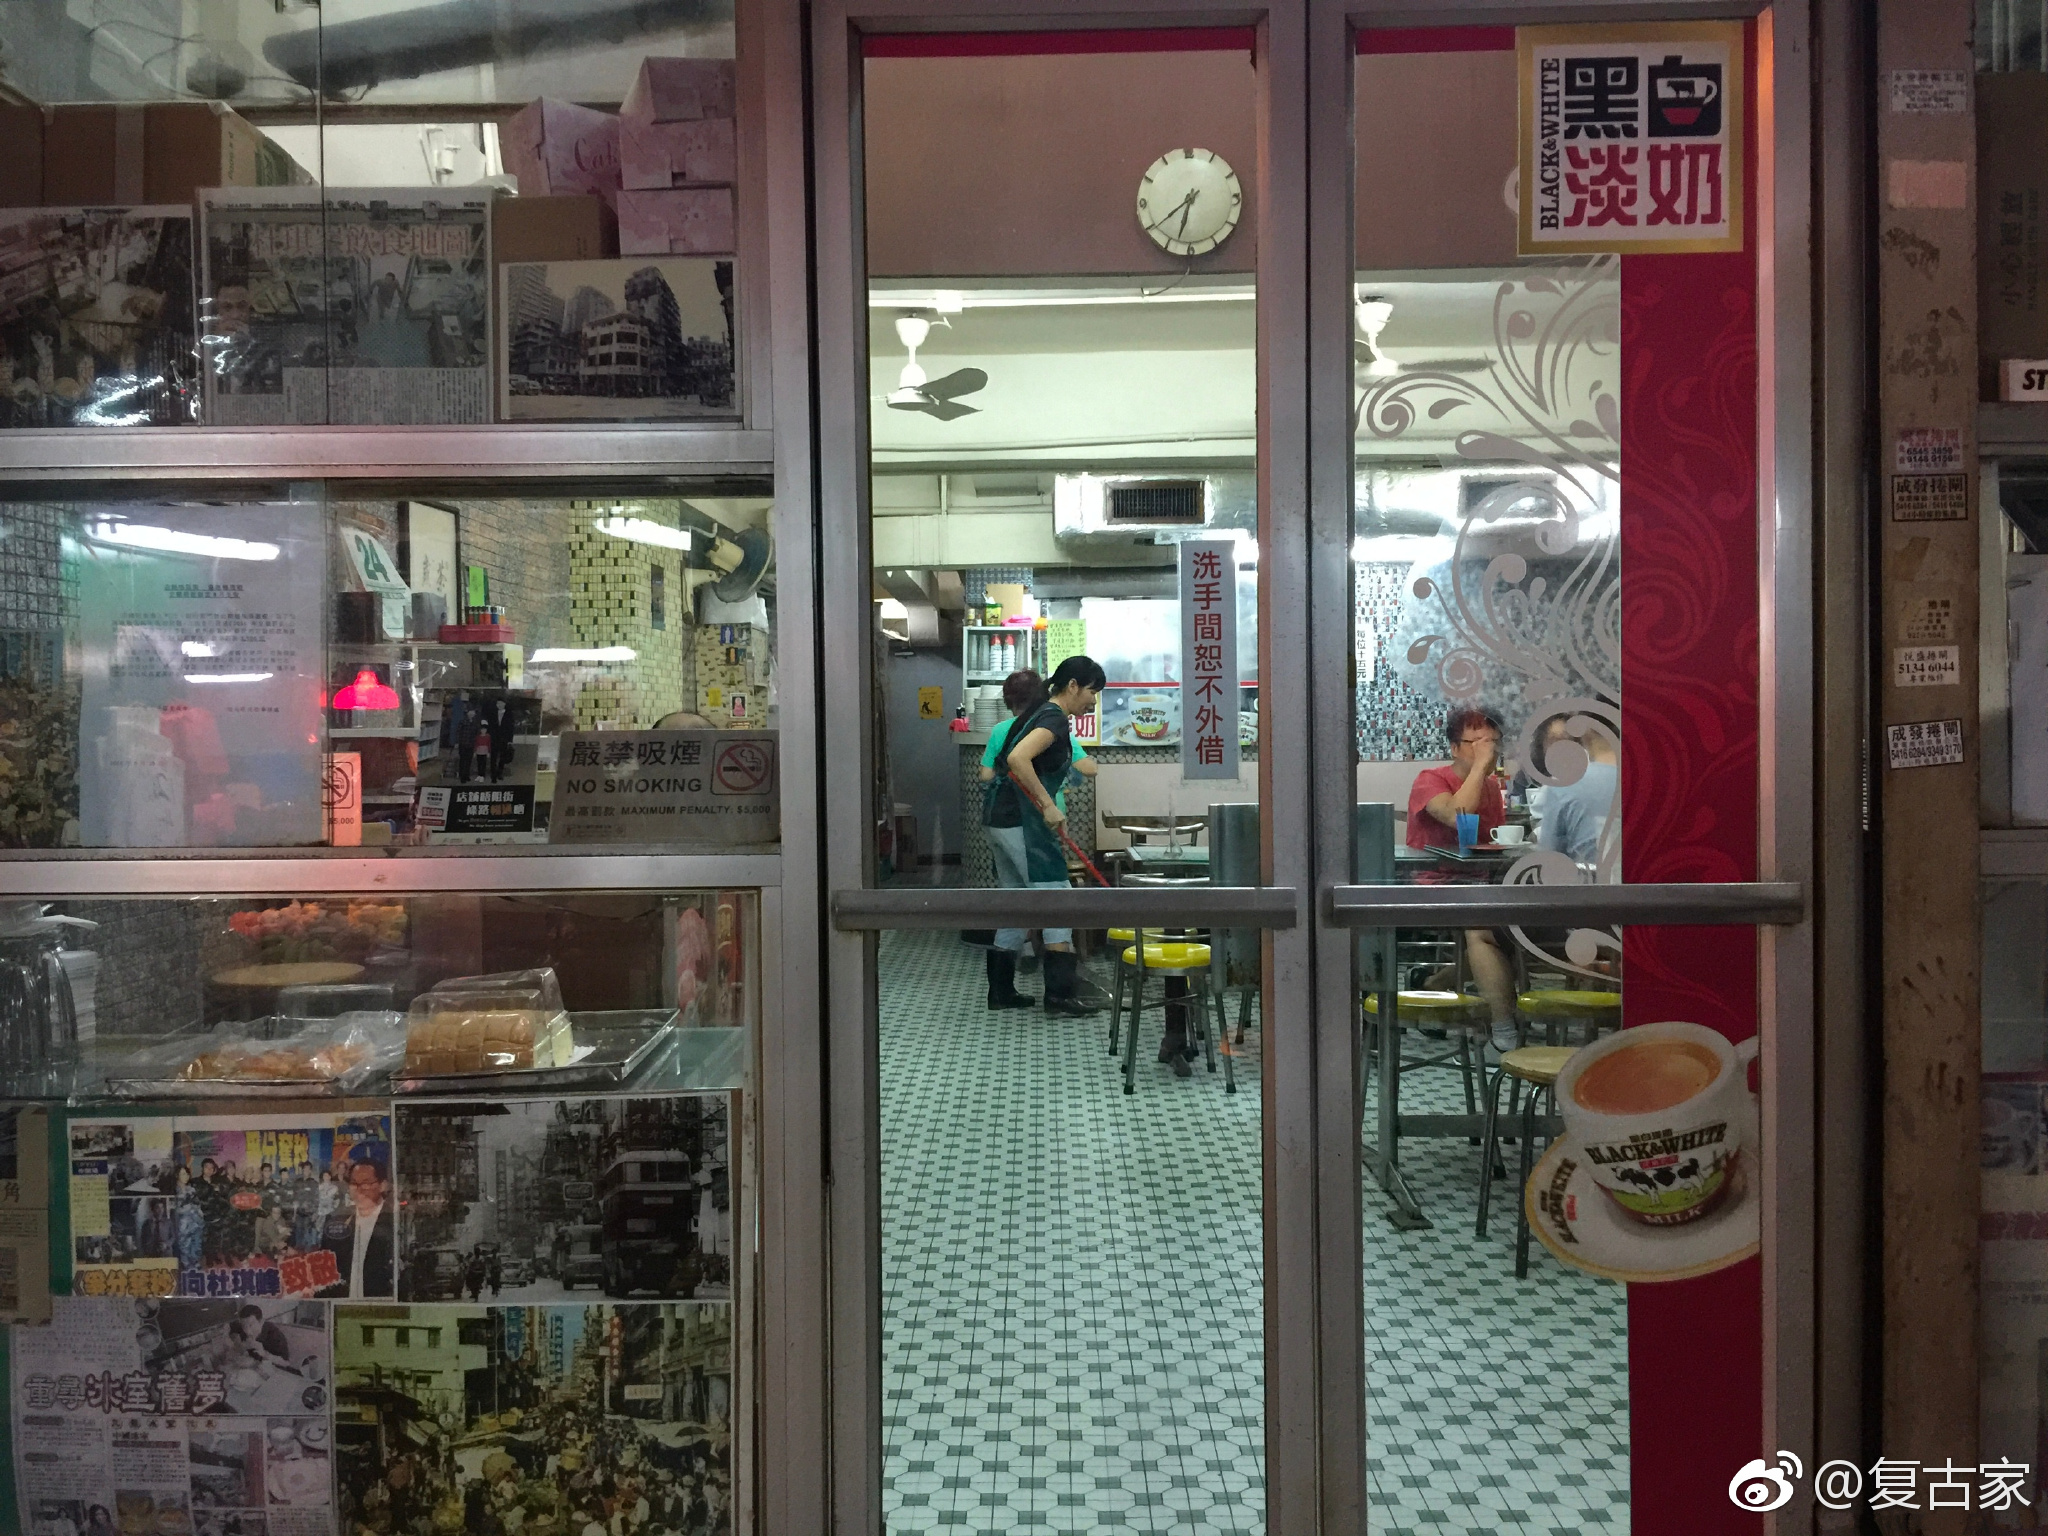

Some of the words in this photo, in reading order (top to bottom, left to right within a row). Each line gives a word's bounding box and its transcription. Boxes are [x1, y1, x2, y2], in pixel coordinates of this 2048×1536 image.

[1563, 56, 1723, 139] 黑白
[1540, 57, 1559, 231] BLACK&WHITE
[1563, 143, 1723, 227] 淡奶
[354, 534, 390, 582] 24
[1192, 551, 1224, 766] 洗手間恕不外借
[1356, 629, 1367, 679] 每位十五元
[1898, 664, 1925, 674] 5134
[1928, 661, 1955, 672] 6044
[1068, 714, 1096, 738] 奶
[1892, 721, 1958, 742] 成發捲閘
[569, 740, 702, 767] 嚴禁吸煙
[566, 779, 597, 794] NO
[603, 778, 702, 794] SMOKING
[564, 806, 615, 817] 最高罰款
[621, 806, 676, 816] MAXIMUM
[680, 806, 734, 815] PENALTY:
[737, 806, 771, 815] $5,000
[1584, 1122, 1728, 1164] BLACK&WHITE
[1644, 1207, 1702, 1225] MILK
[23, 1371, 227, 1414] 重尋冰室舊夢
